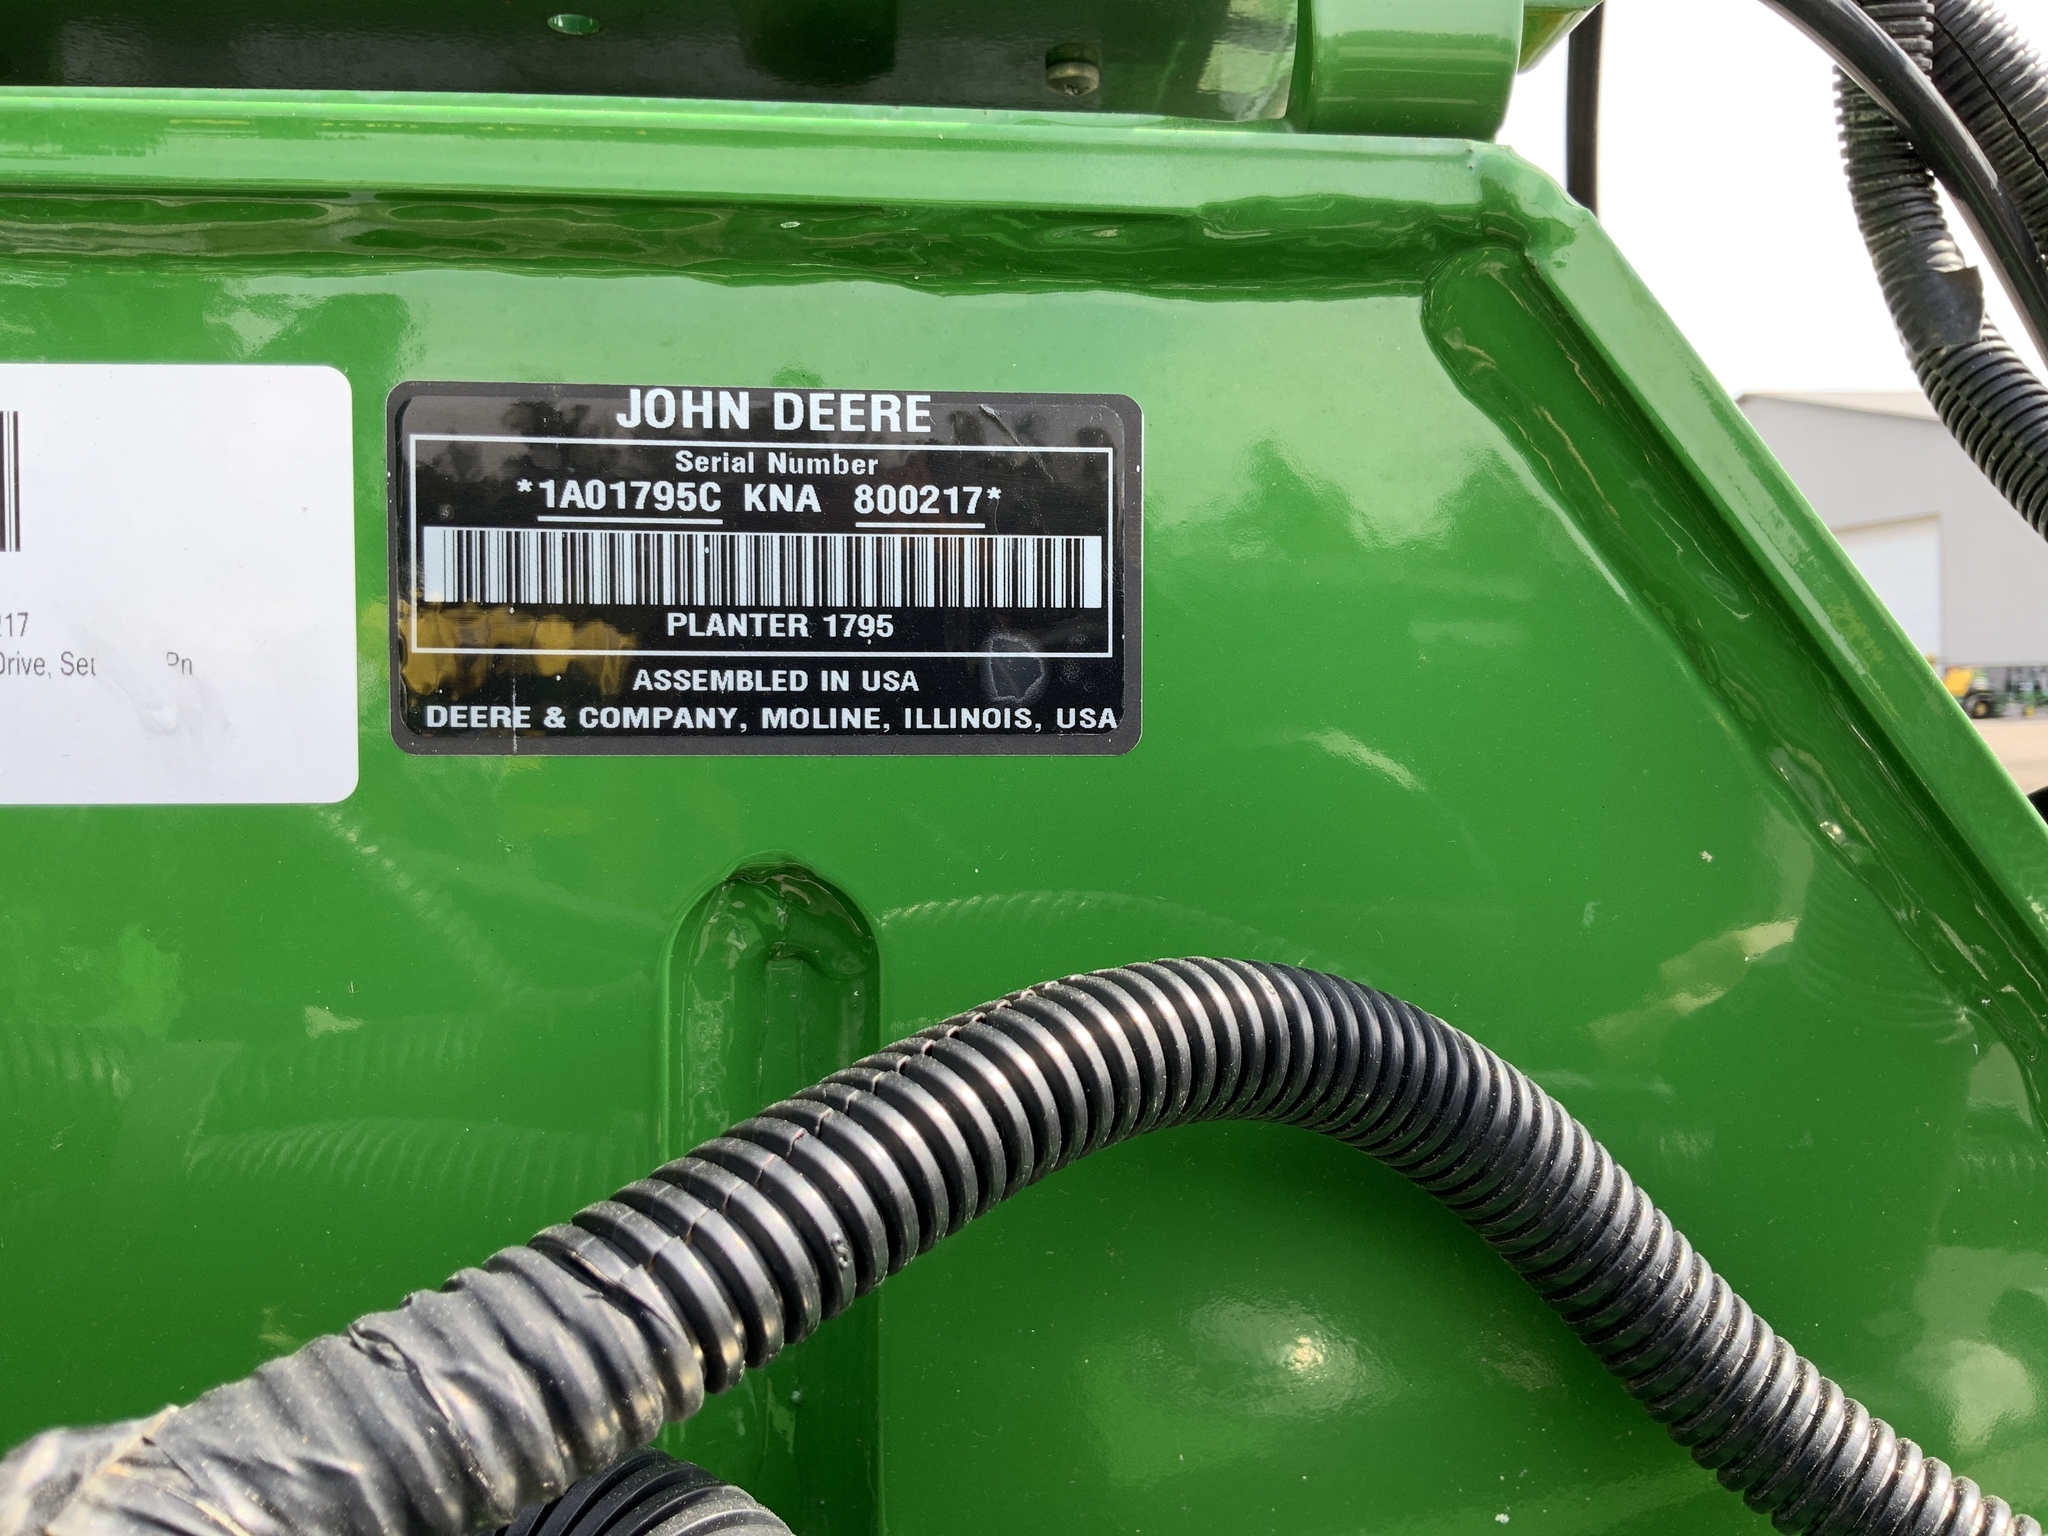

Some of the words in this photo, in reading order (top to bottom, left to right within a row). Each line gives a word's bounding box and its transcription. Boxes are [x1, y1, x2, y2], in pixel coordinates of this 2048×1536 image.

[615, 386, 751, 429] JOHN
[773, 391, 932, 433] DEERE
[675, 450, 754, 473] Serial
[768, 452, 879, 475] Number
[744, 483, 822, 513] KNA
[0, 612, 28, 637] 17
[667, 612, 809, 637] PLANTER
[823, 614, 894, 638] 1795
[632, 669, 808, 692] ASSEMBLED
[821, 670, 850, 692] IN
[862, 670, 920, 692] USA
[426, 705, 532, 728] DEERE
[543, 706, 567, 729] &
[579, 706, 747, 733] COMPANY,
[762, 707, 890, 733] MOLINE,
[904, 707, 1042, 733] ILLINOIS,
[1056, 707, 1118, 729] USA
